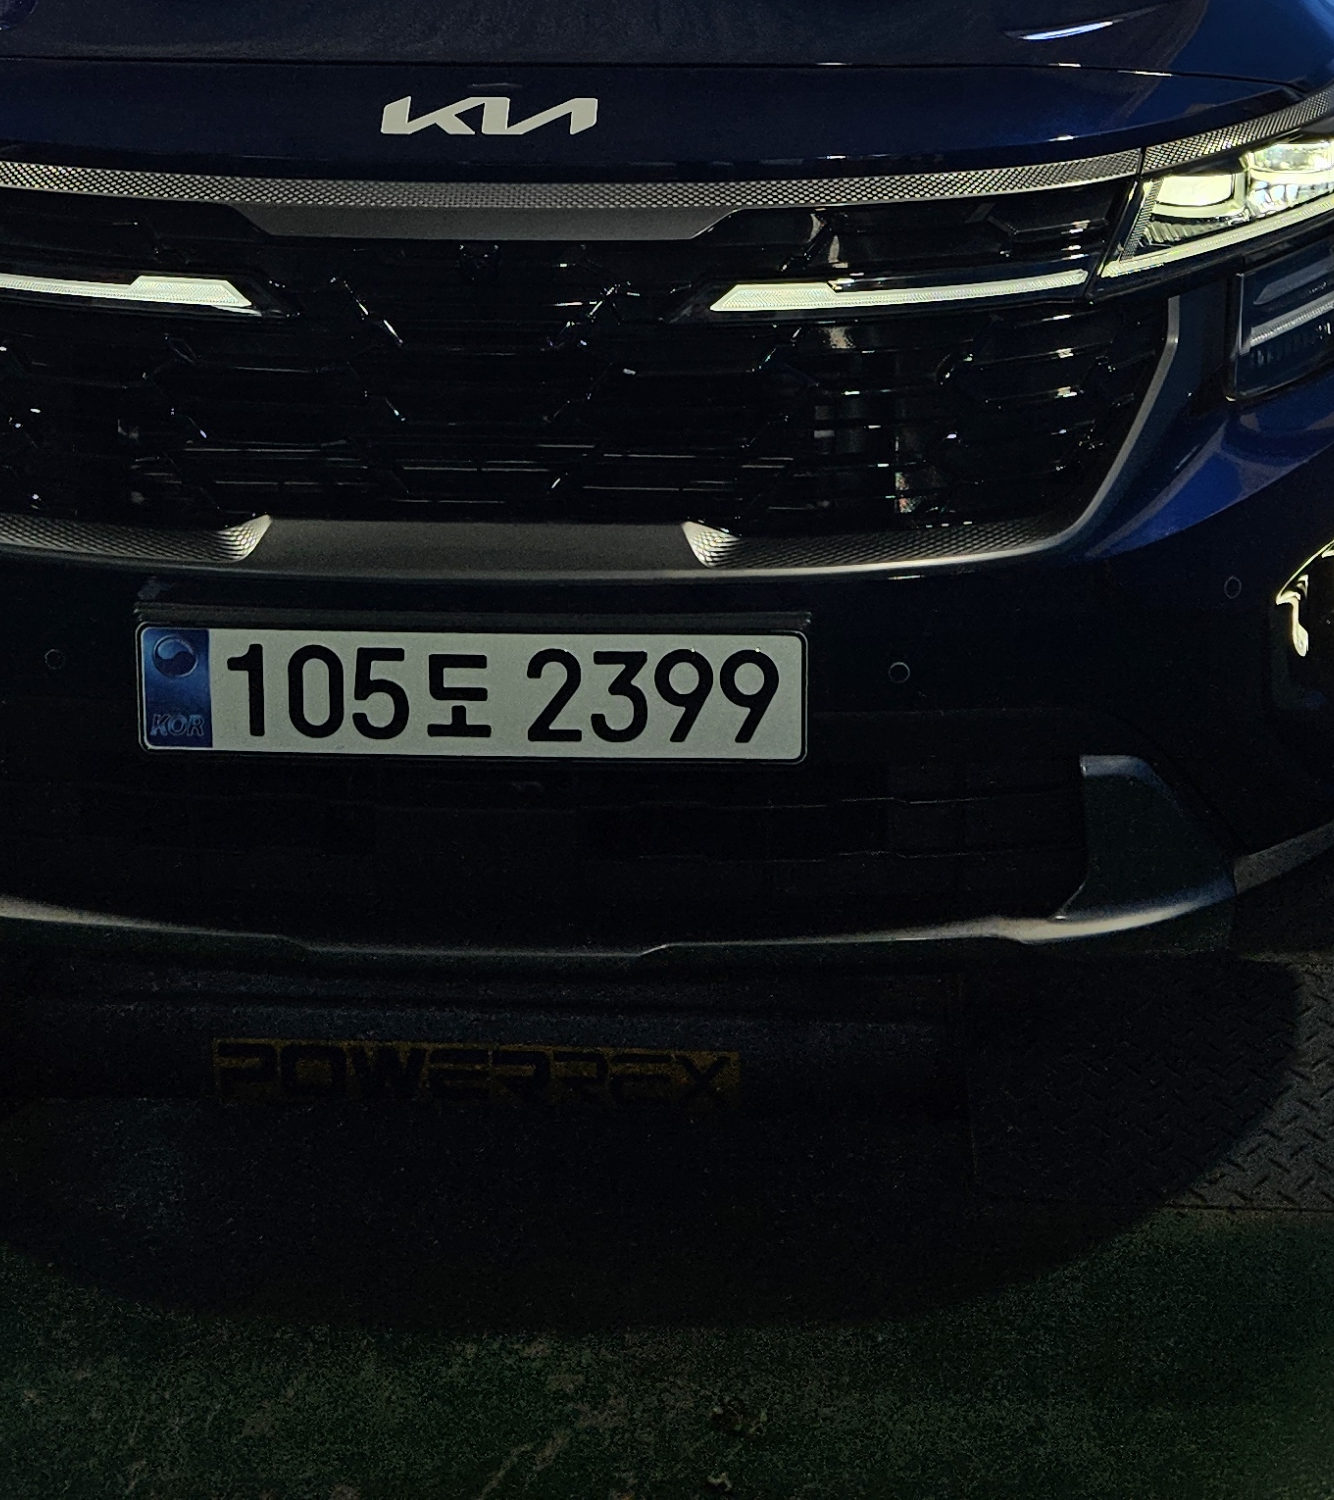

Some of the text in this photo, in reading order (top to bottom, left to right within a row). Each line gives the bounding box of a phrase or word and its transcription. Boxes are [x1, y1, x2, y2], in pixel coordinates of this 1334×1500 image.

[150, 712, 205, 738] KOR
[226, 643, 780, 744] 105도 2399
